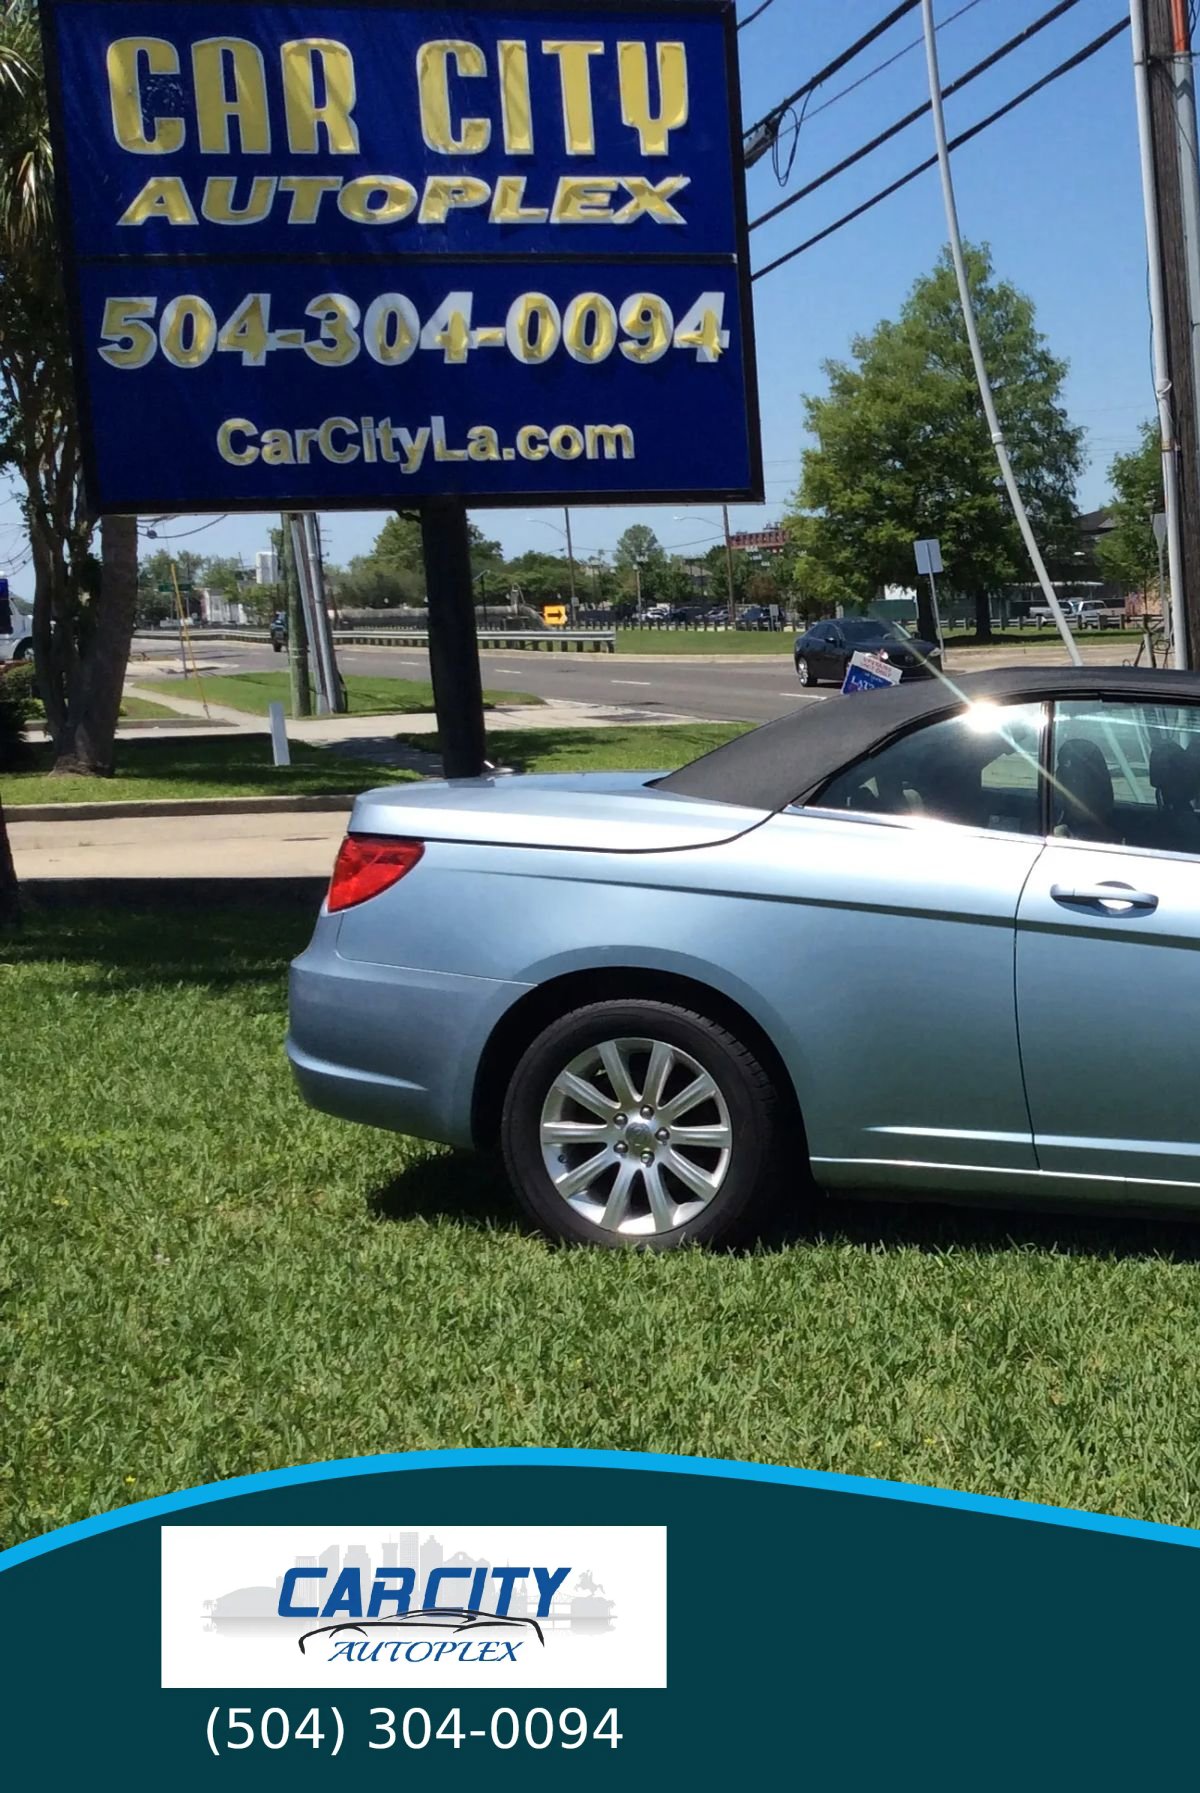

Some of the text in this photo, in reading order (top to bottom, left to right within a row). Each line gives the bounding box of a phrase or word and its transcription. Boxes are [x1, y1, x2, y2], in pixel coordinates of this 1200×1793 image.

[107, 37, 689, 156] CAR CITY
[117, 176, 690, 225] AUTOPLEX
[98, 291, 730, 369] 504-304-0094
[216, 416, 635, 473] CarCityLa.com
